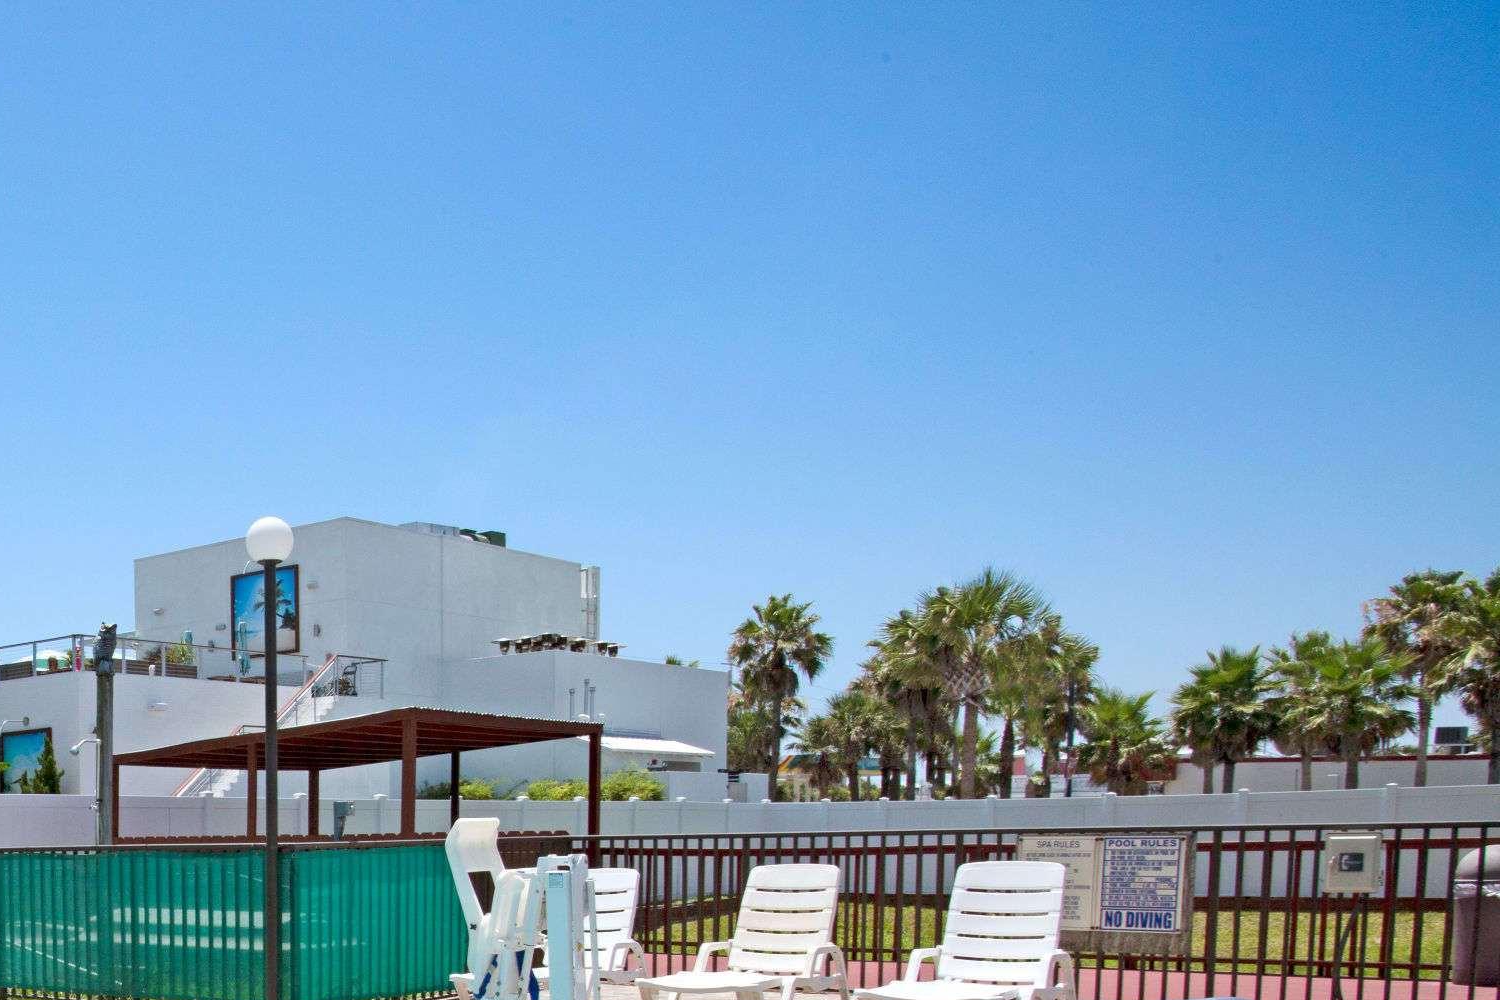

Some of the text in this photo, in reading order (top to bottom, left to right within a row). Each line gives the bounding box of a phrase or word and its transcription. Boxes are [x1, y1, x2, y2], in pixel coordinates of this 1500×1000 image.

[1053, 840, 1081, 849] RULES
[1108, 839, 1178, 848] POOL RULES
[1104, 910, 1173, 930] NO DIVING
